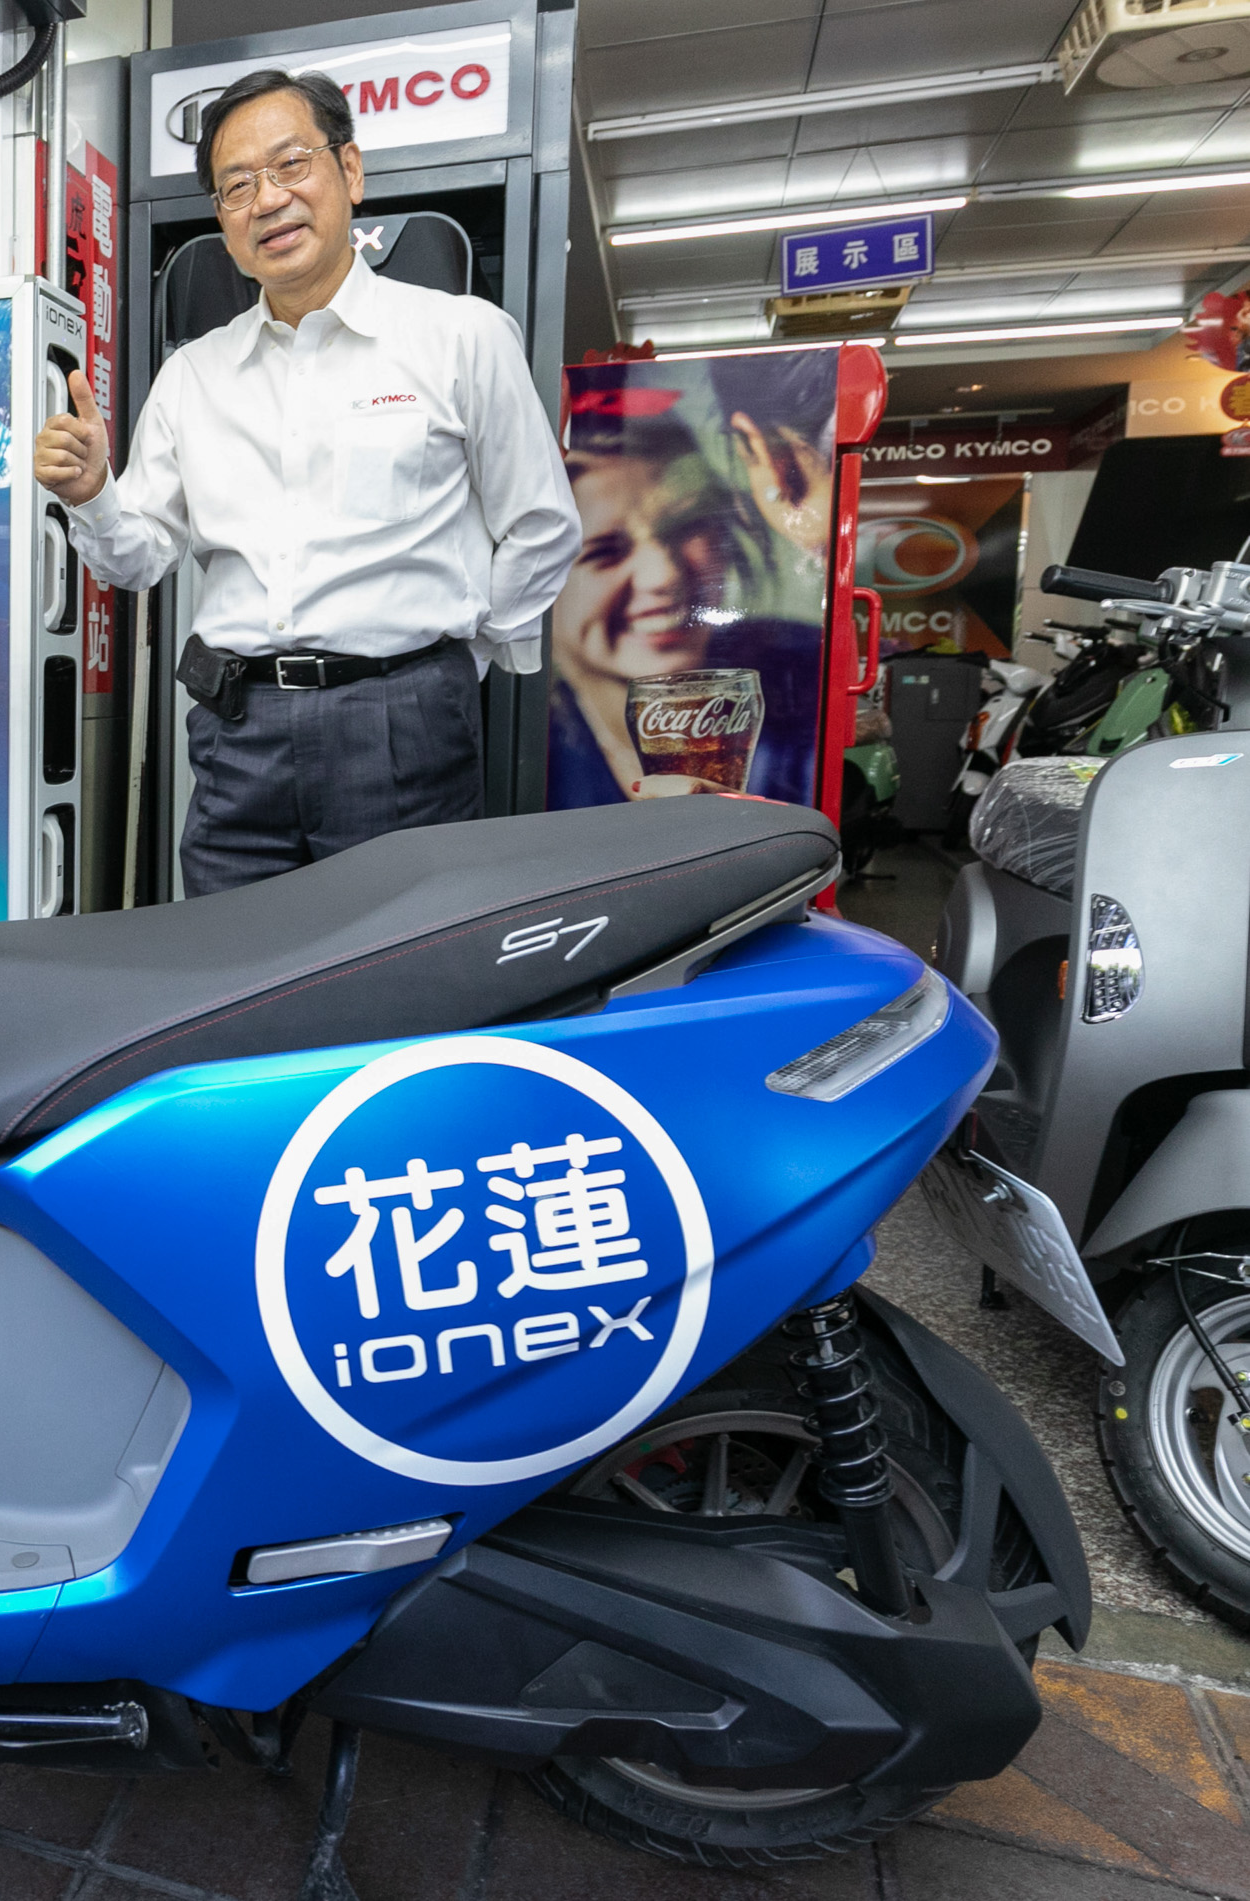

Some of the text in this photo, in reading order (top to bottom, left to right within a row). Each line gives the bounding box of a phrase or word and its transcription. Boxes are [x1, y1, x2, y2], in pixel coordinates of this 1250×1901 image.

[342, 63, 491, 114] MCO
[792, 231, 921, 278] 展示區
[45, 304, 83, 340] ionex
[371, 394, 417, 406] KYMCO
[954, 438, 1054, 459] KYMCO
[853, 609, 954, 634] YMCO
[496, 915, 610, 965] S7
[313, 1132, 649, 1319] 花蓮
[333, 1295, 655, 1388] ionex
